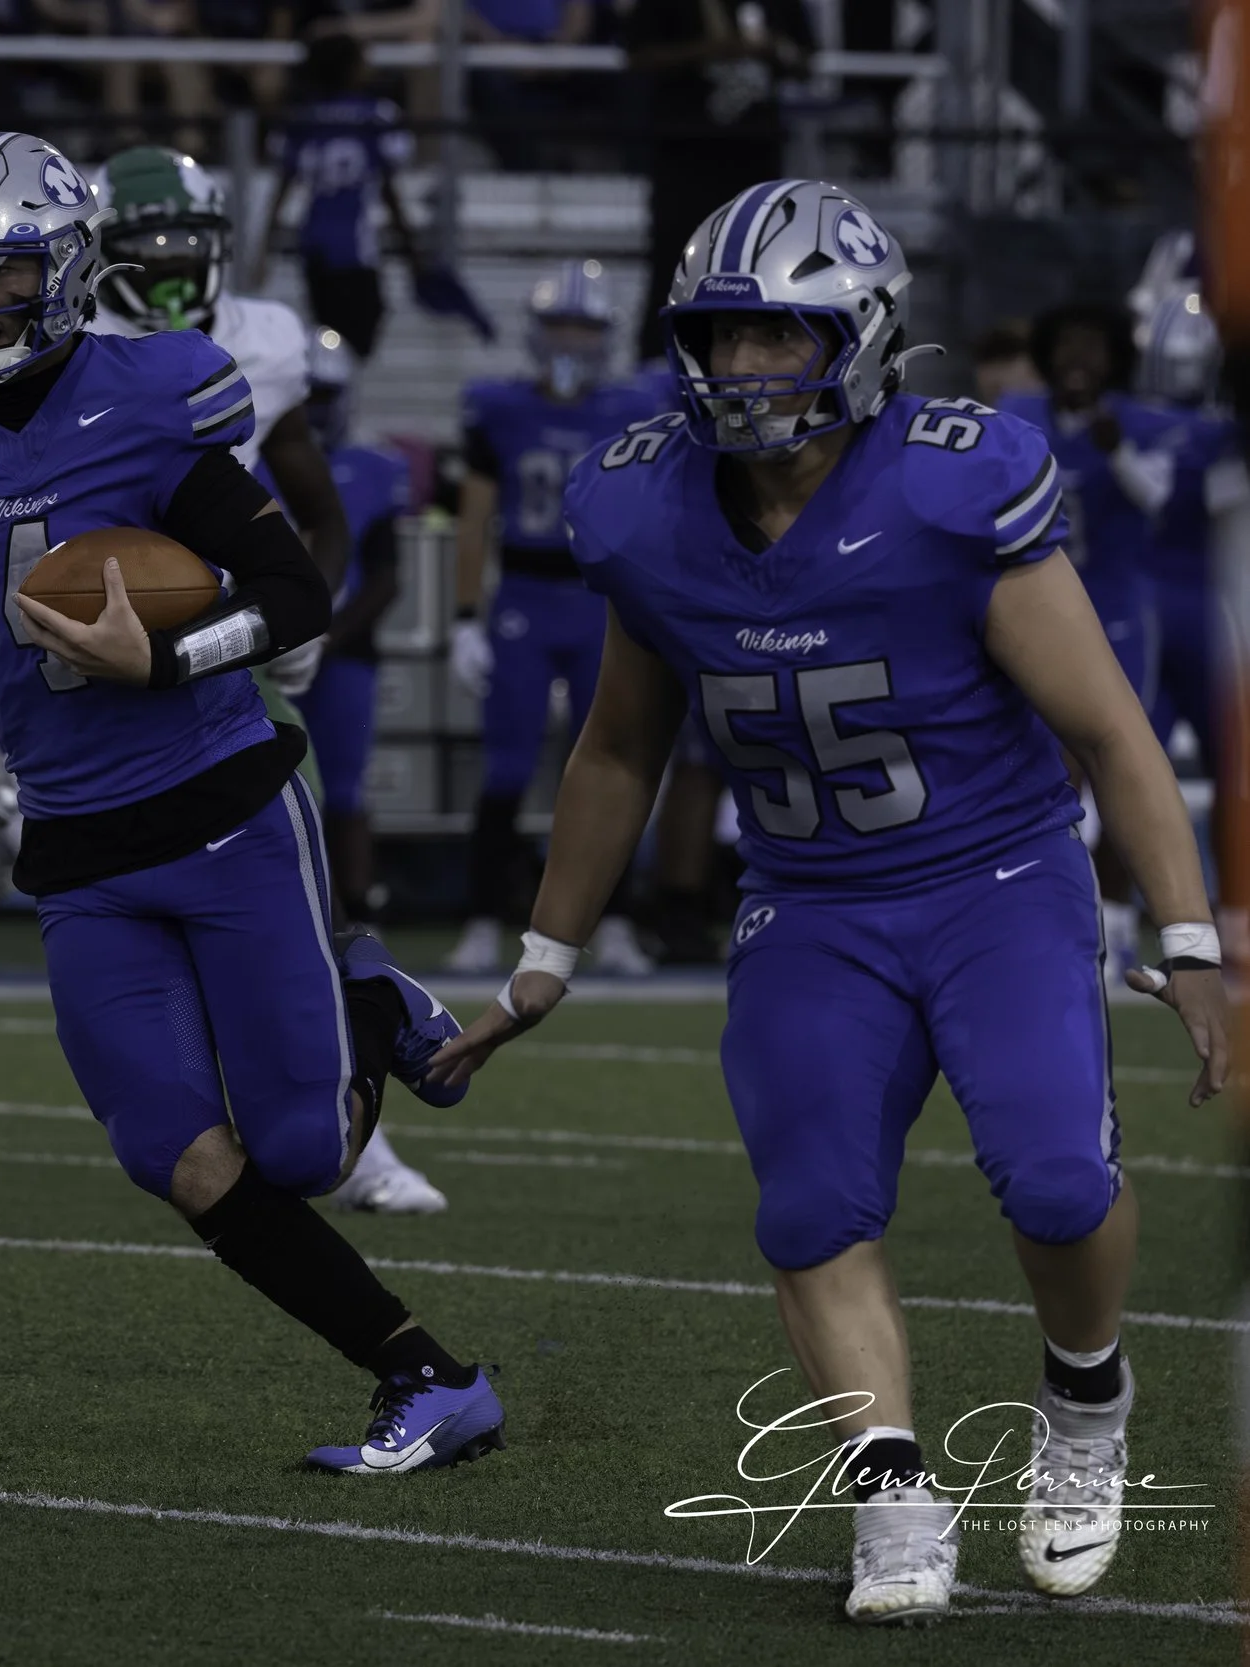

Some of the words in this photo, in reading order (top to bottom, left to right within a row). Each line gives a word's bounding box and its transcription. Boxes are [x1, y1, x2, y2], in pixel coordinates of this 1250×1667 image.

[703, 277, 750, 296] Vikings
[734, 627, 829, 656] Vikings
[696, 657, 930, 841] 55
